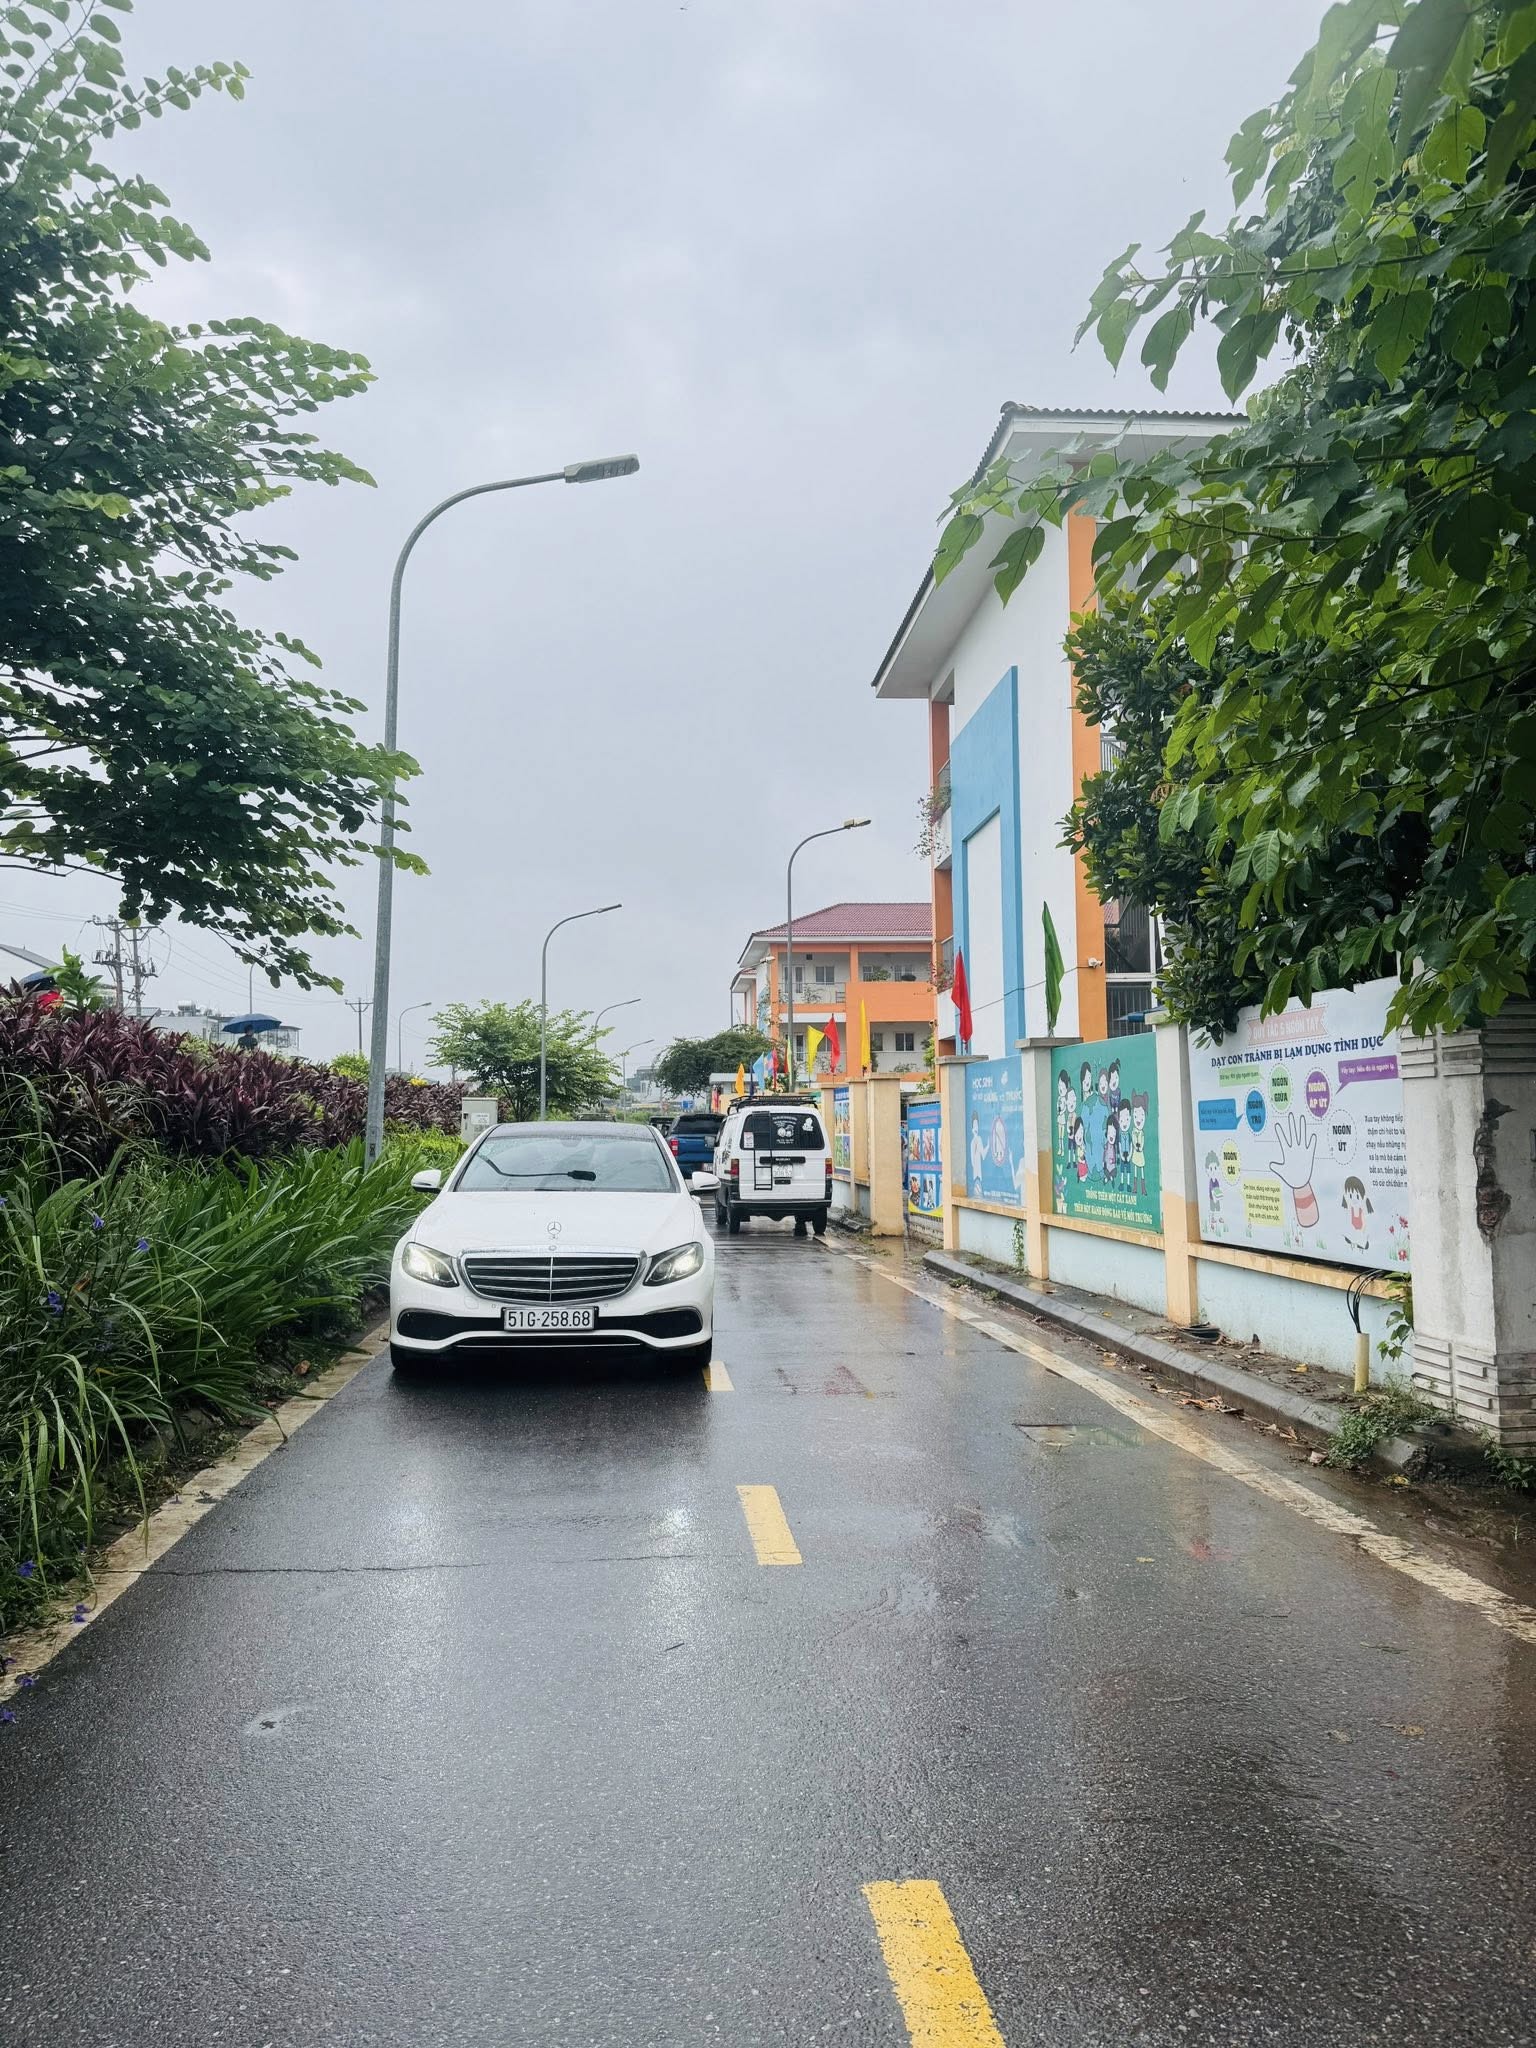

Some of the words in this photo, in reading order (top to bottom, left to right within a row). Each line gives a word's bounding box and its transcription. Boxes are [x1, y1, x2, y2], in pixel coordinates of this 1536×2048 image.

[1211, 1055, 1226, 1068] DẠY
[1227, 1053, 1242, 1065] CON
[1244, 1049, 1272, 1063] TRÁNH
[1274, 1048, 1283, 1061] BỊ
[1284, 1046, 1303, 1060] LẠM
[1305, 1042, 1332, 1057] DỤNG
[1334, 1037, 1359, 1052] TÌNH
[1272, 1075, 1288, 1086] NGÓN
[1332, 1122, 1351, 1135] NGÓN
[508, 1311, 590, 1327] 51G-258.68
